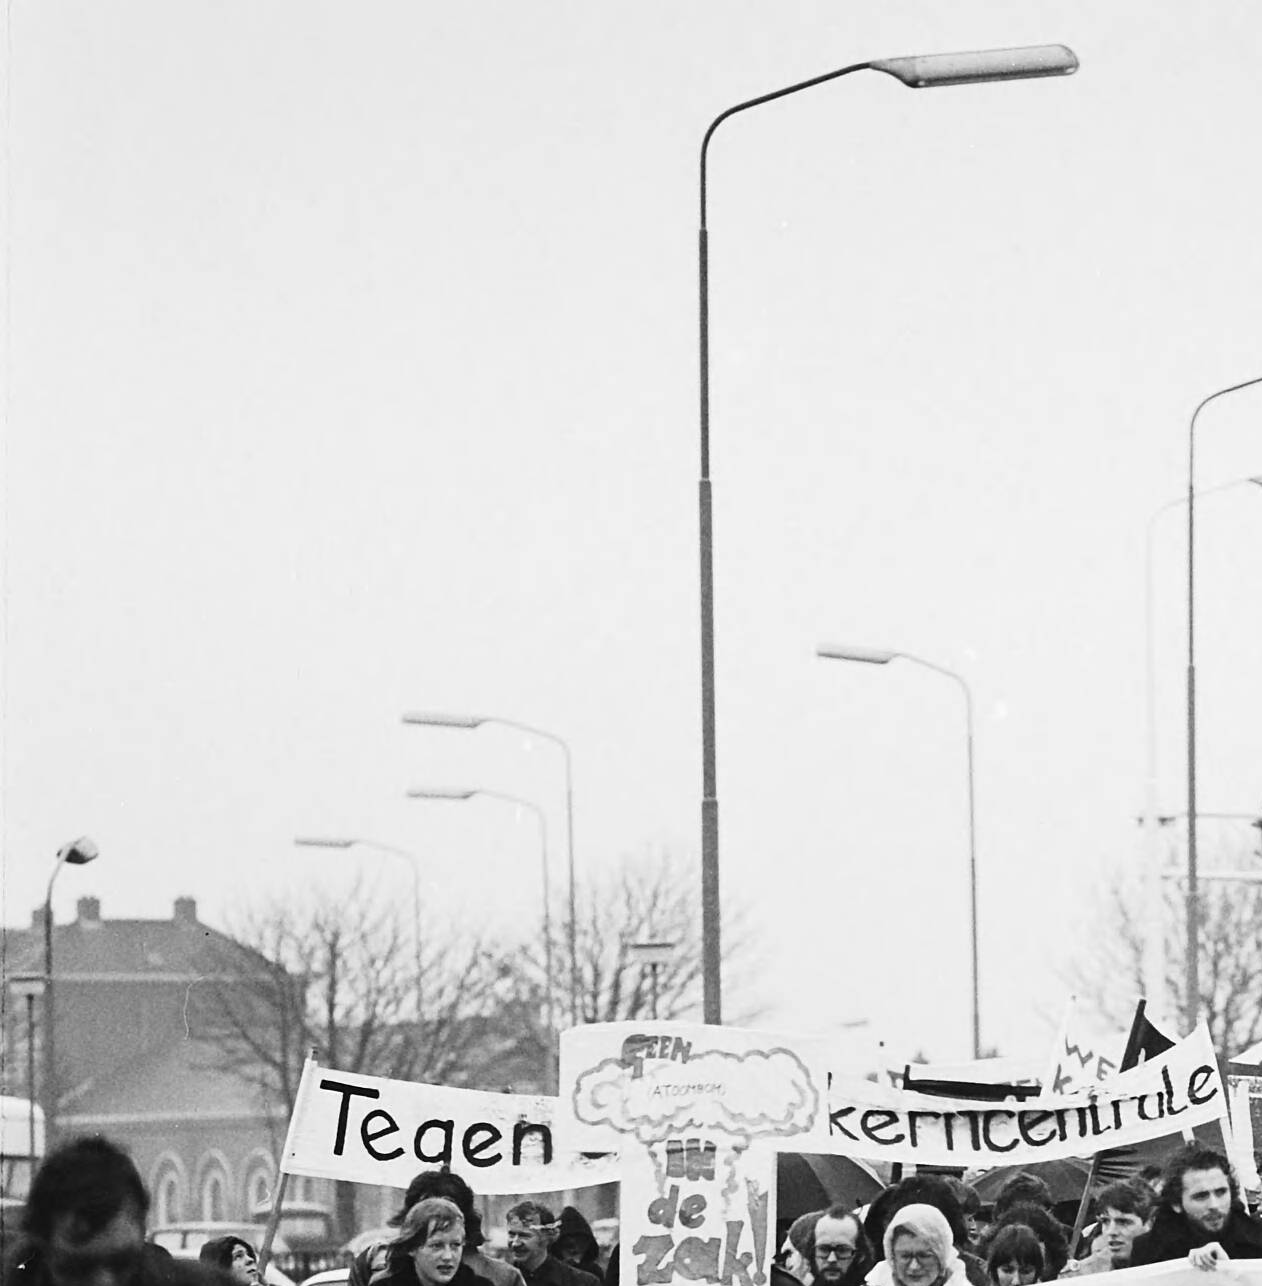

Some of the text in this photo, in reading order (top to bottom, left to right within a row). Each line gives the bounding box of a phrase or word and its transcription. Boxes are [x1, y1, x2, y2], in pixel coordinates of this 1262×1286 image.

[320, 1066, 1218, 1173] Tegen kerncentrale
[648, 1184, 707, 1229] de
